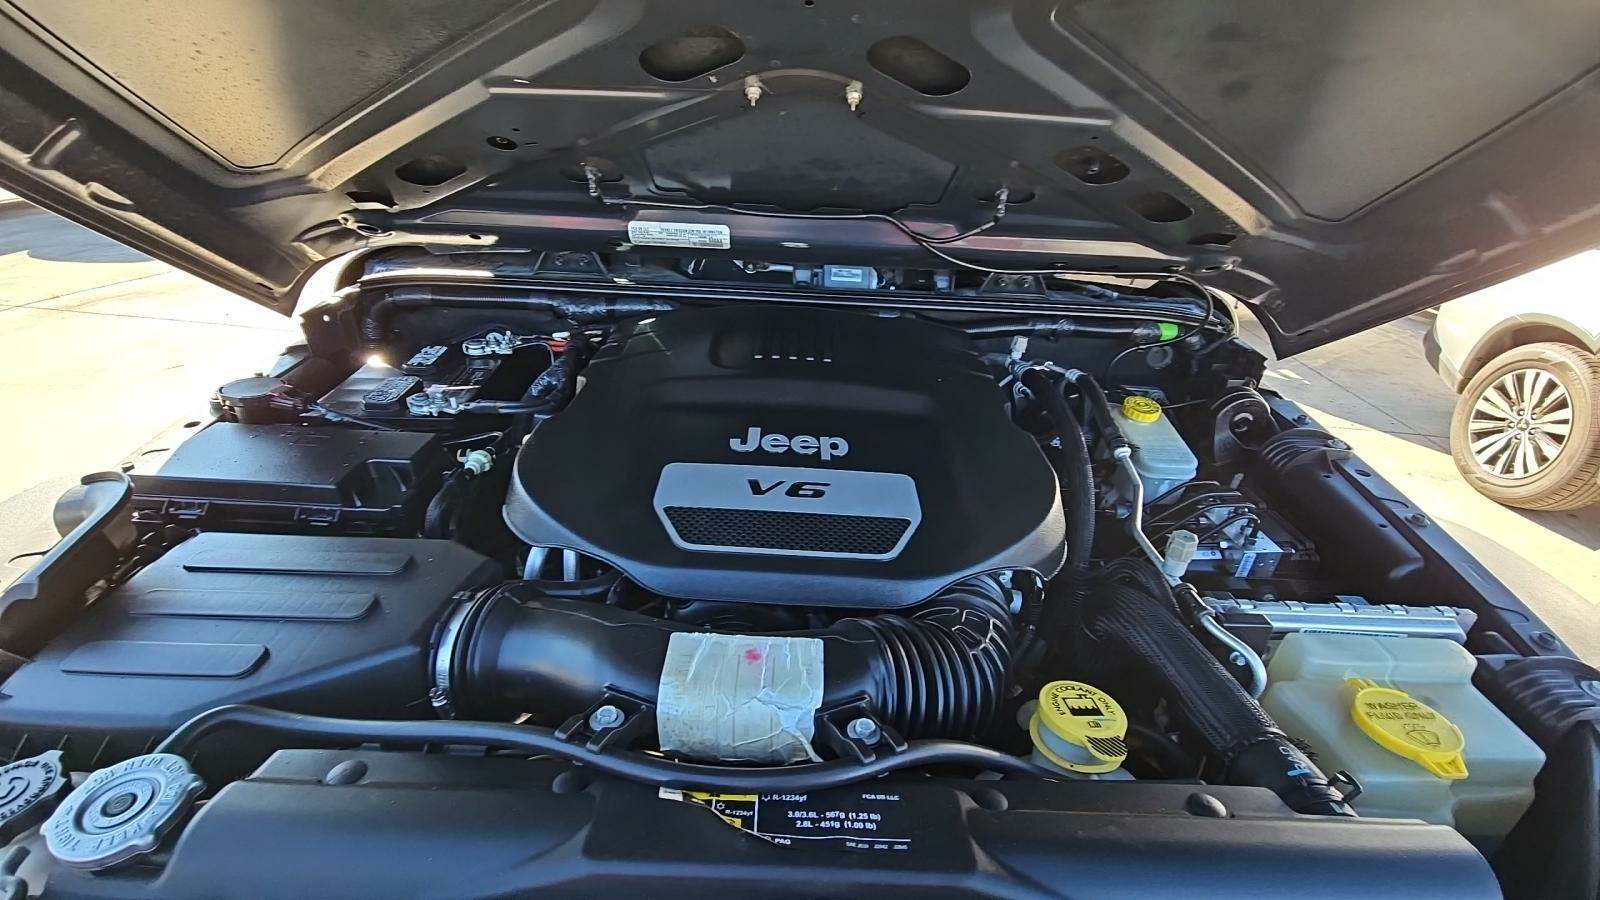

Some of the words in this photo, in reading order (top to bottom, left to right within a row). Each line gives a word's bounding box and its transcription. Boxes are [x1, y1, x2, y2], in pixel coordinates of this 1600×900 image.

[729, 427, 849, 461] Jeep
[747, 478, 832, 499] V6
[1056, 685, 1098, 697] COOLANT
[1097, 697, 1116, 716] ONLY
[772, 794, 808, 803] R-1234yf
